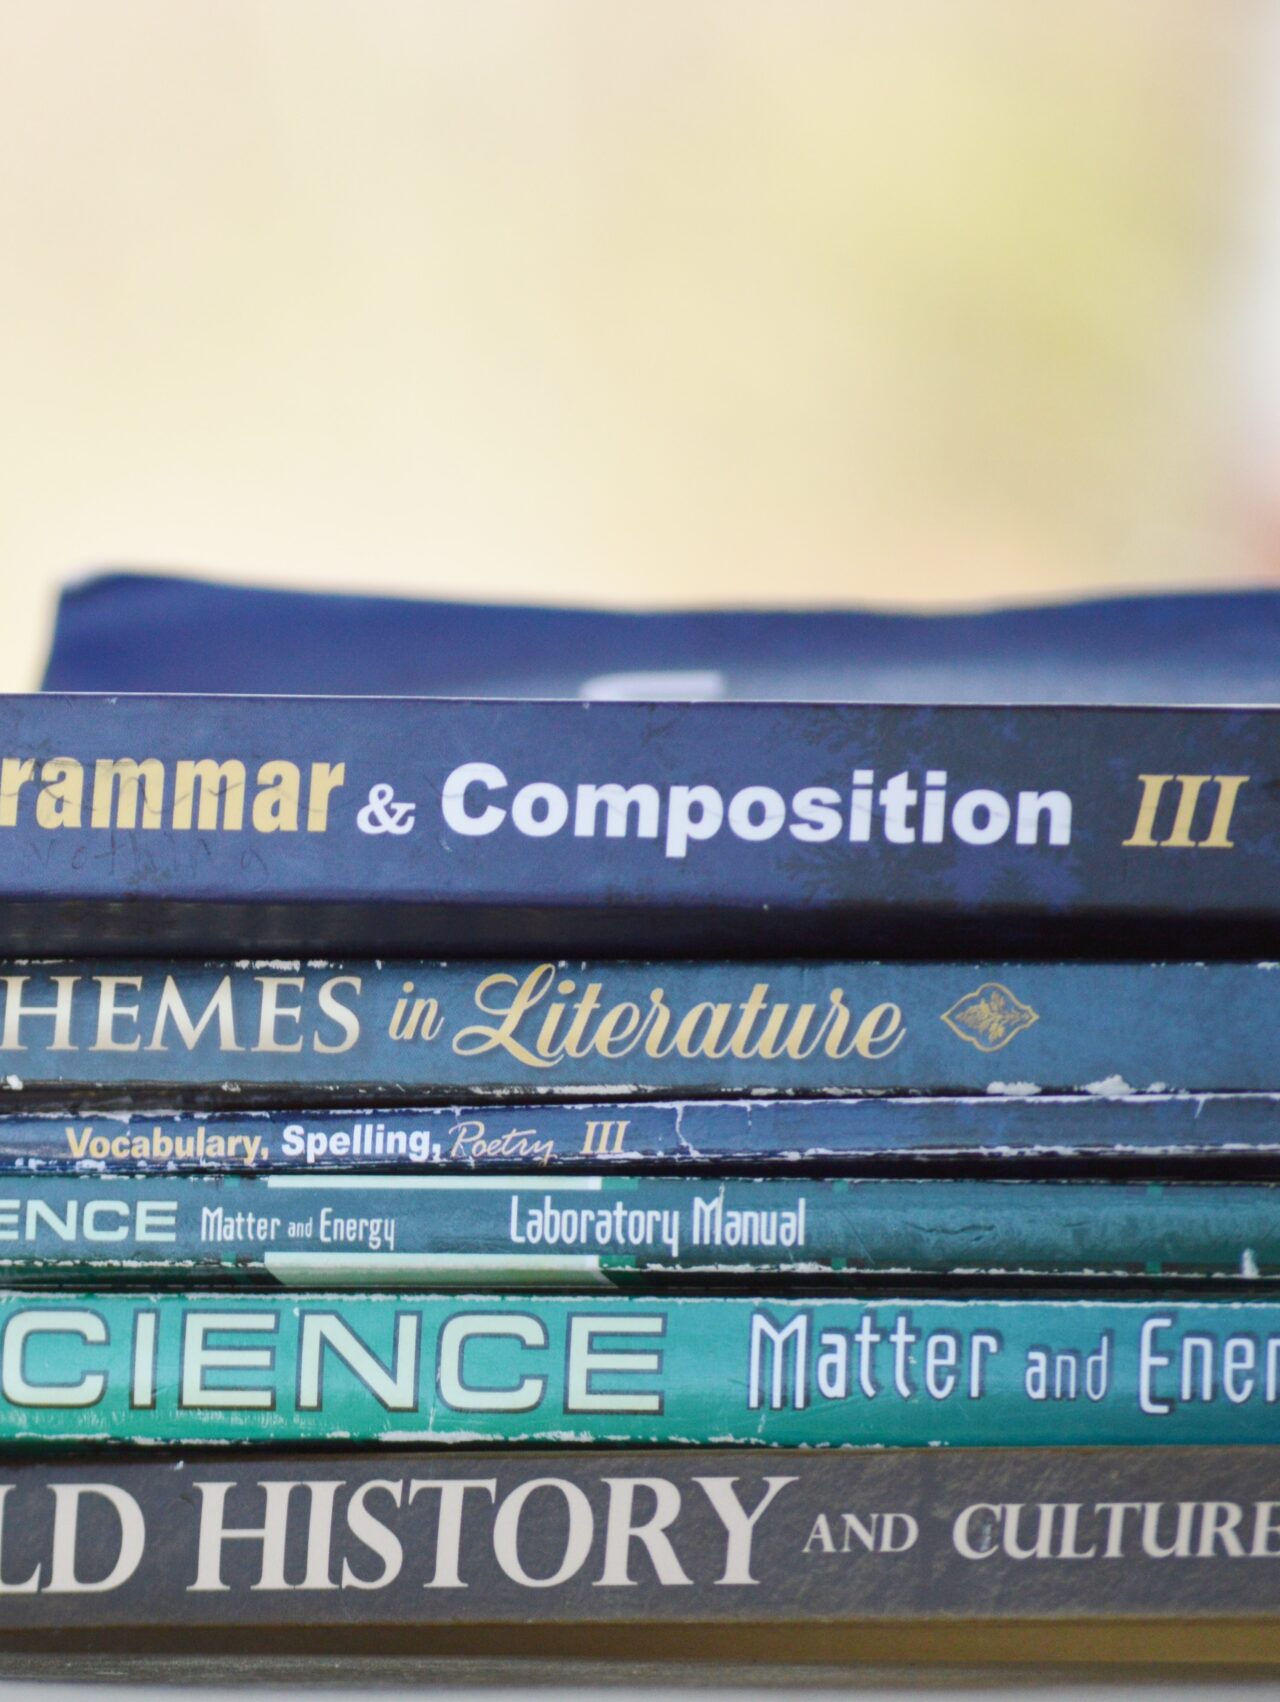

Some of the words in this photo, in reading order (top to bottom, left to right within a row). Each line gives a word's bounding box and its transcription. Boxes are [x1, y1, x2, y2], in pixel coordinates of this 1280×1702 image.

[356, 782, 416, 835] &
[441, 761, 1074, 858] Composition
[1122, 773, 1251, 849] III
[387, 980, 446, 1042] in
[452, 962, 906, 1068] Literature
[64, 1125, 270, 1168] Vocabulary,
[281, 1123, 443, 1163] Spelling,
[448, 1119, 556, 1167] Poetry
[579, 1119, 631, 1155] III
[200, 1206, 281, 1243] Matter
[287, 1216, 313, 1239] and
[319, 1207, 396, 1251] Energy
[510, 1194, 680, 1257] Laboratory
[692, 1195, 806, 1247] Manual
[746, 1309, 1000, 1411] Matter
[1023, 1331, 1109, 1402] and
[186, 1475, 800, 1591] HISTORY
[802, 1511, 920, 1554] AND
[951, 1500, 1280, 1561] CULTURE
